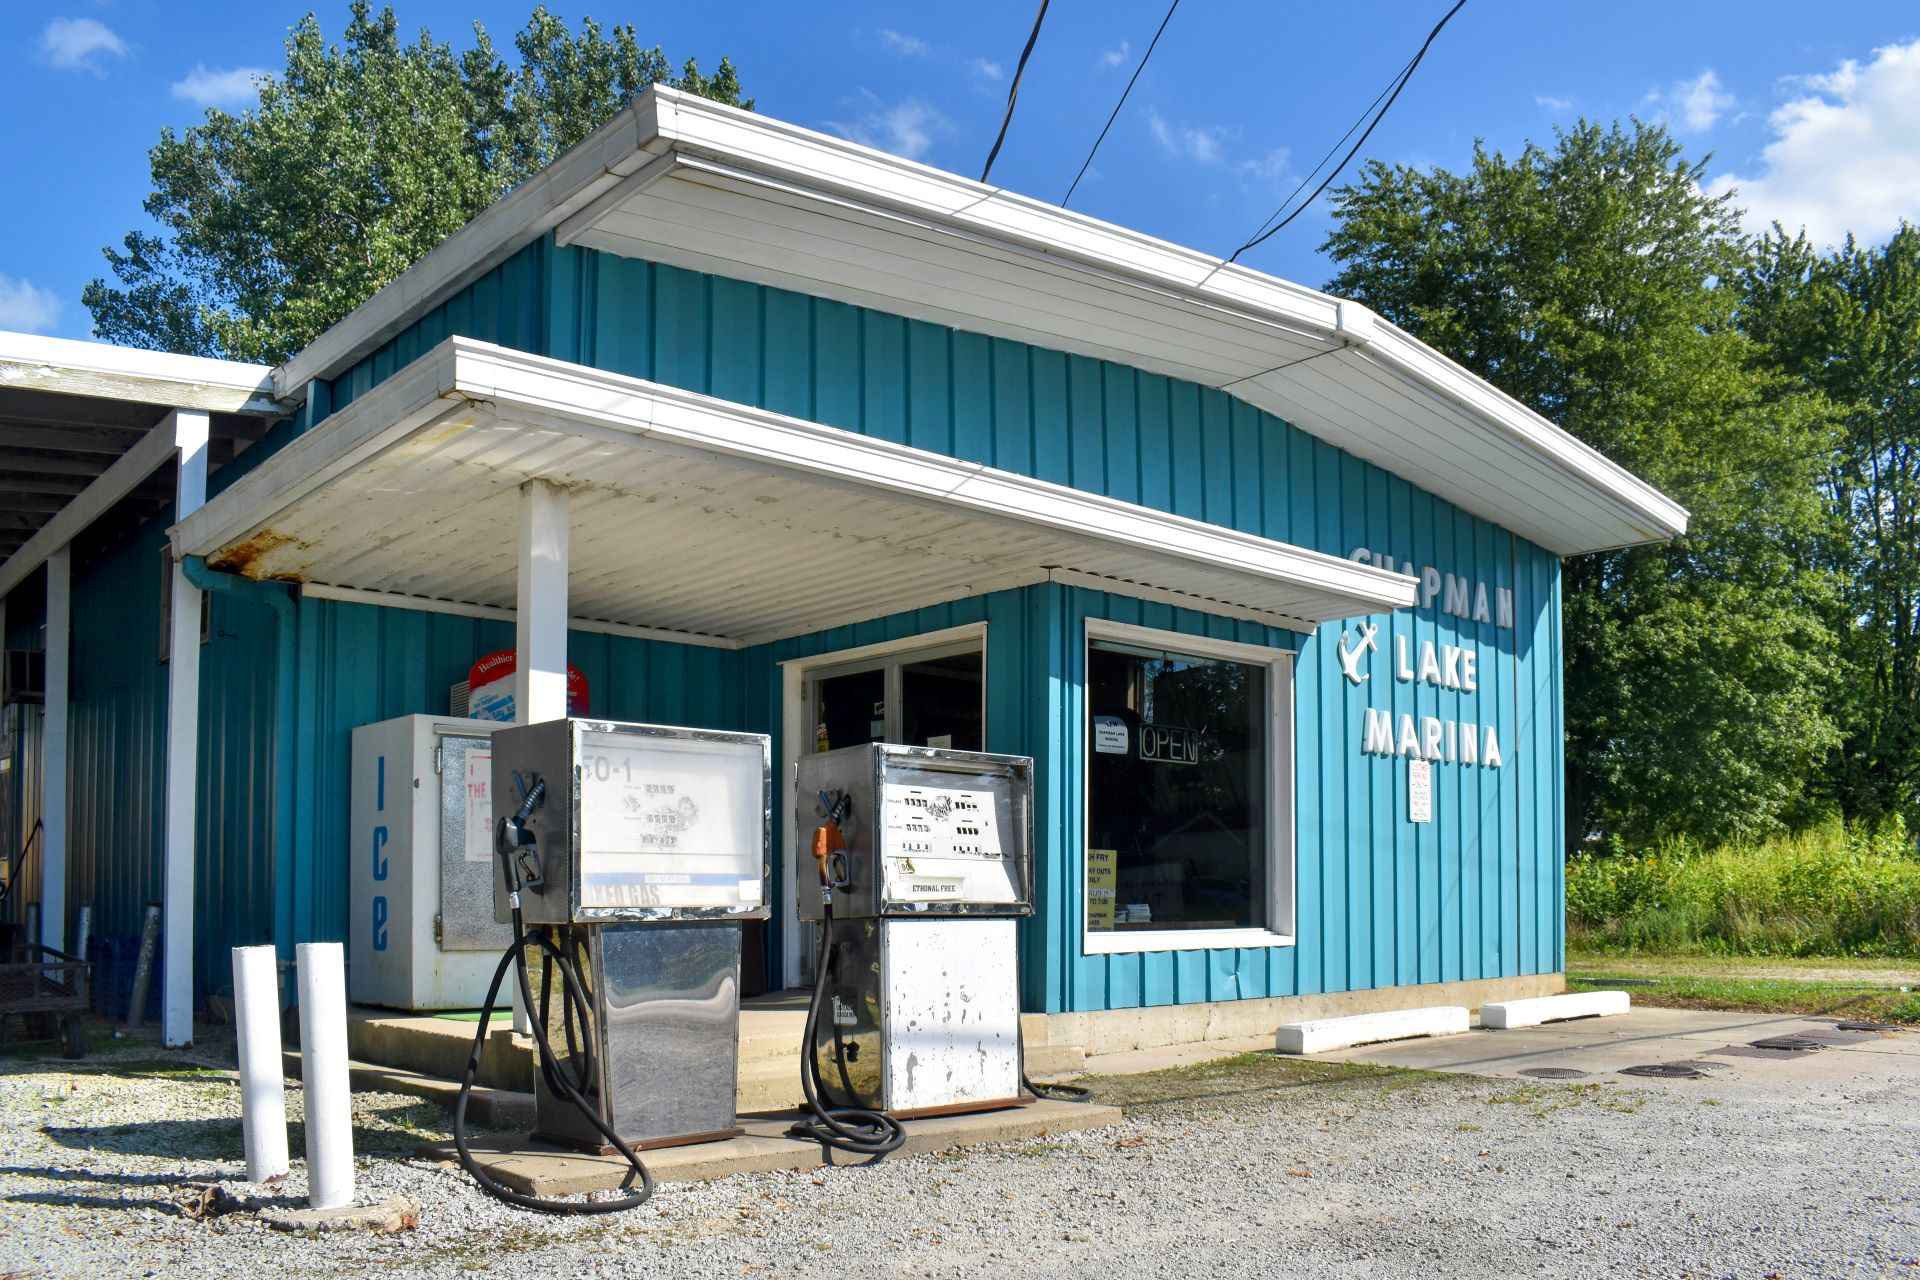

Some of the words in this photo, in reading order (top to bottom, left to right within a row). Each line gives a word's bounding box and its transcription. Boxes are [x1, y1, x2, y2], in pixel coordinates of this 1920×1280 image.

[478, 654, 513, 673] Healthier
[1395, 634, 1477, 692] LAKE
[1143, 727, 1195, 761] OPEN
[1363, 707, 1502, 767] MARINA
[467, 783, 486, 798] THE
[1096, 854, 1109, 862] FRY
[628, 884, 661, 906] GAS
[912, 884, 939, 892] ETHONAL
[940, 884, 956, 892] FREE
